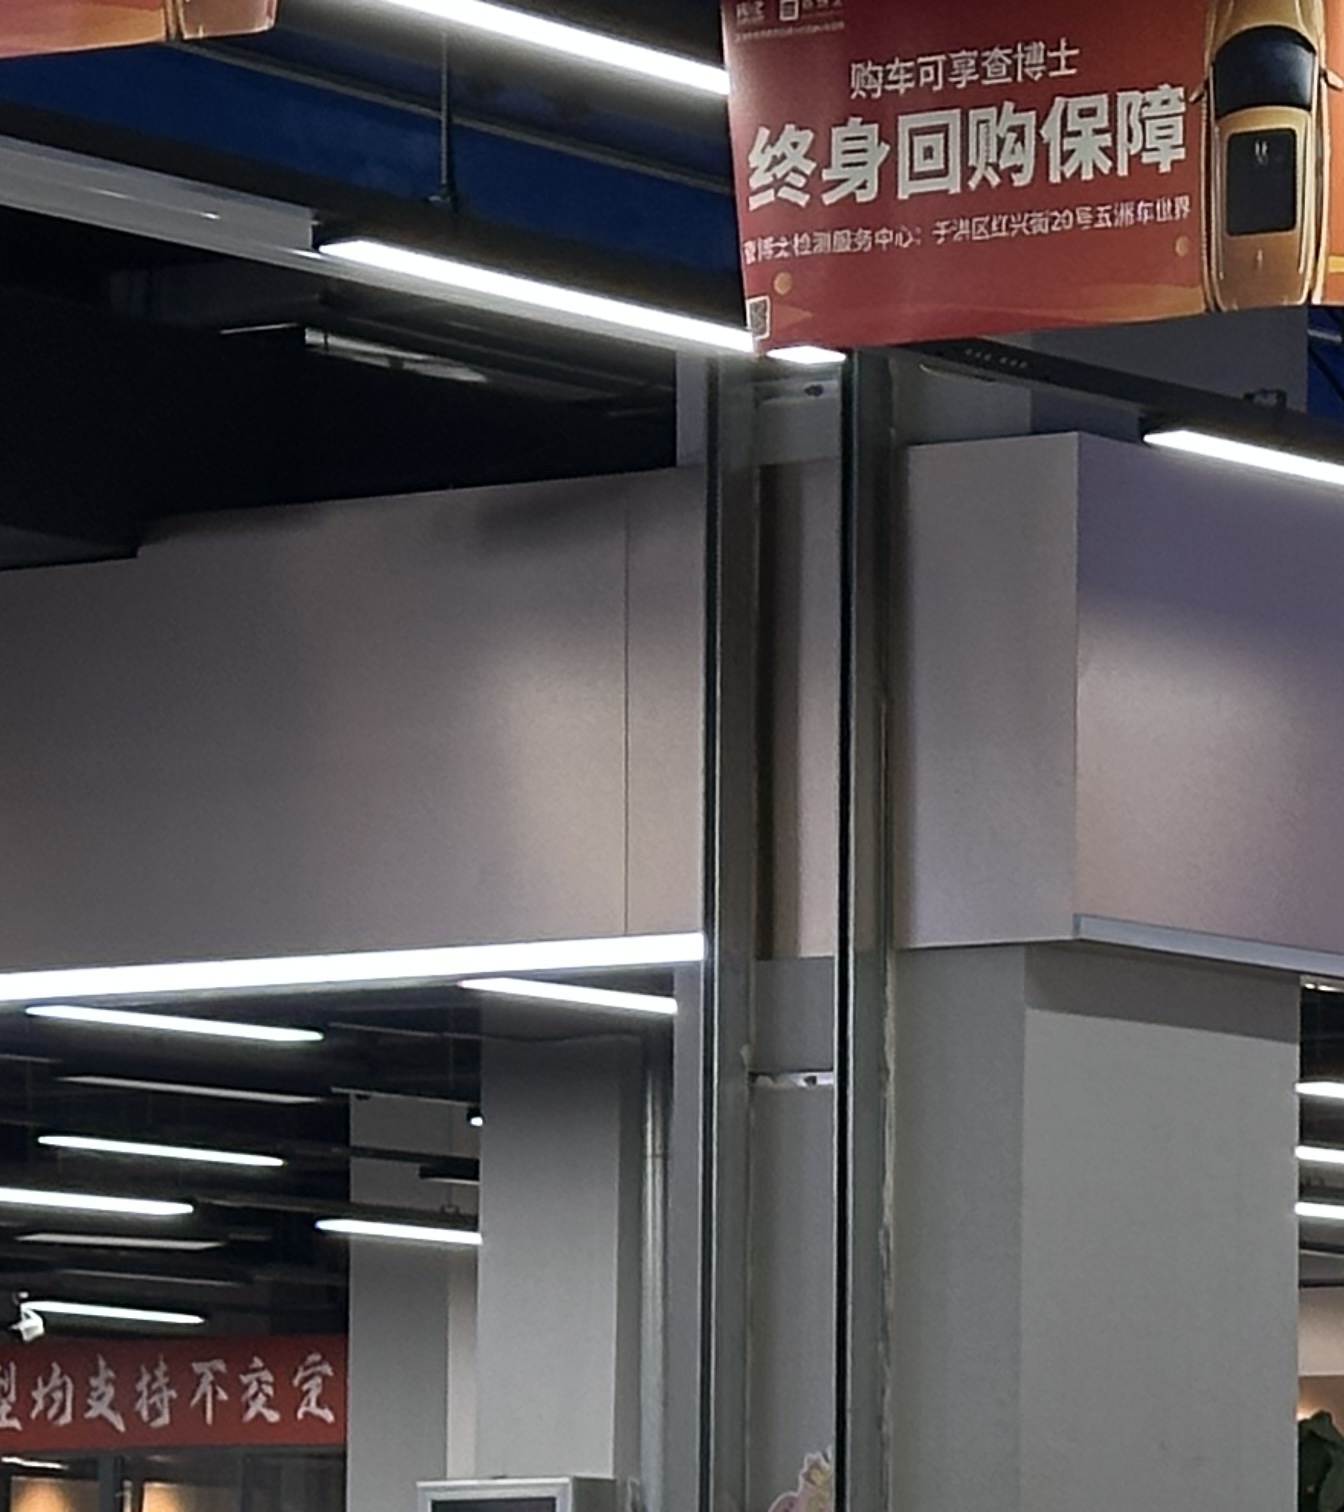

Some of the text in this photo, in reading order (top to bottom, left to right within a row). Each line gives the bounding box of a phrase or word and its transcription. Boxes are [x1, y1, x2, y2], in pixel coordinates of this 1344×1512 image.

[849, 38, 1080, 101] 购车可享查博士
[747, 83, 1187, 212] 终身回购保障
